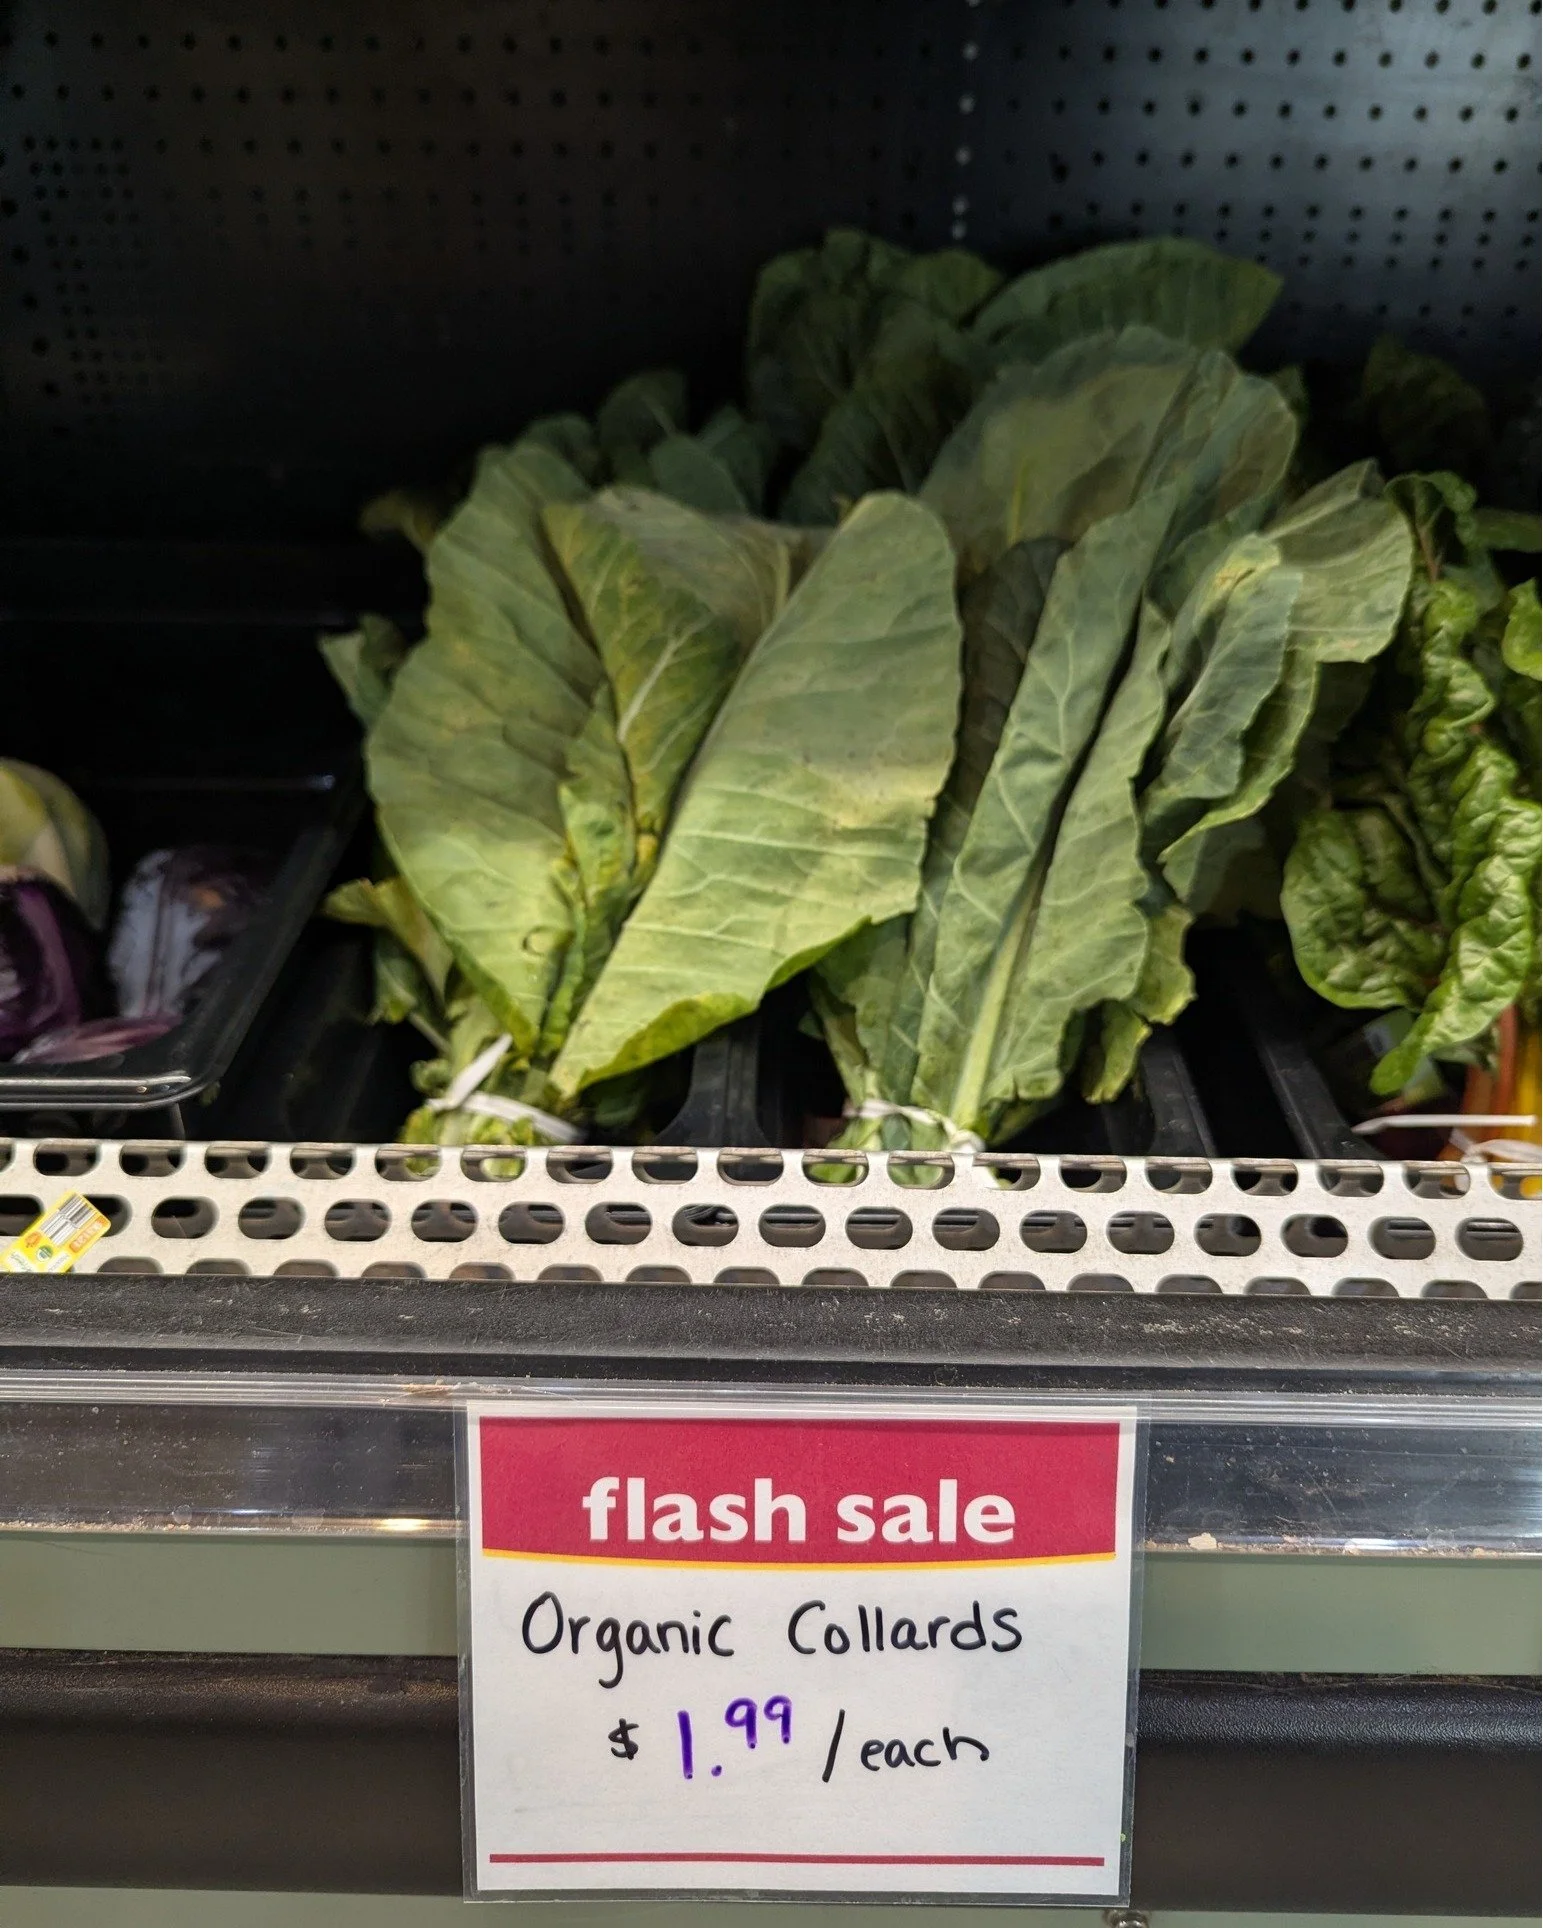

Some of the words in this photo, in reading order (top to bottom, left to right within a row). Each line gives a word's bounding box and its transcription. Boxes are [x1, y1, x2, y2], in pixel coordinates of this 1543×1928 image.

[583, 1477, 806, 1543] flash
[837, 1479, 1016, 1544] sale
[522, 1592, 735, 1690] Organic
[788, 1601, 1023, 1655] Collards
